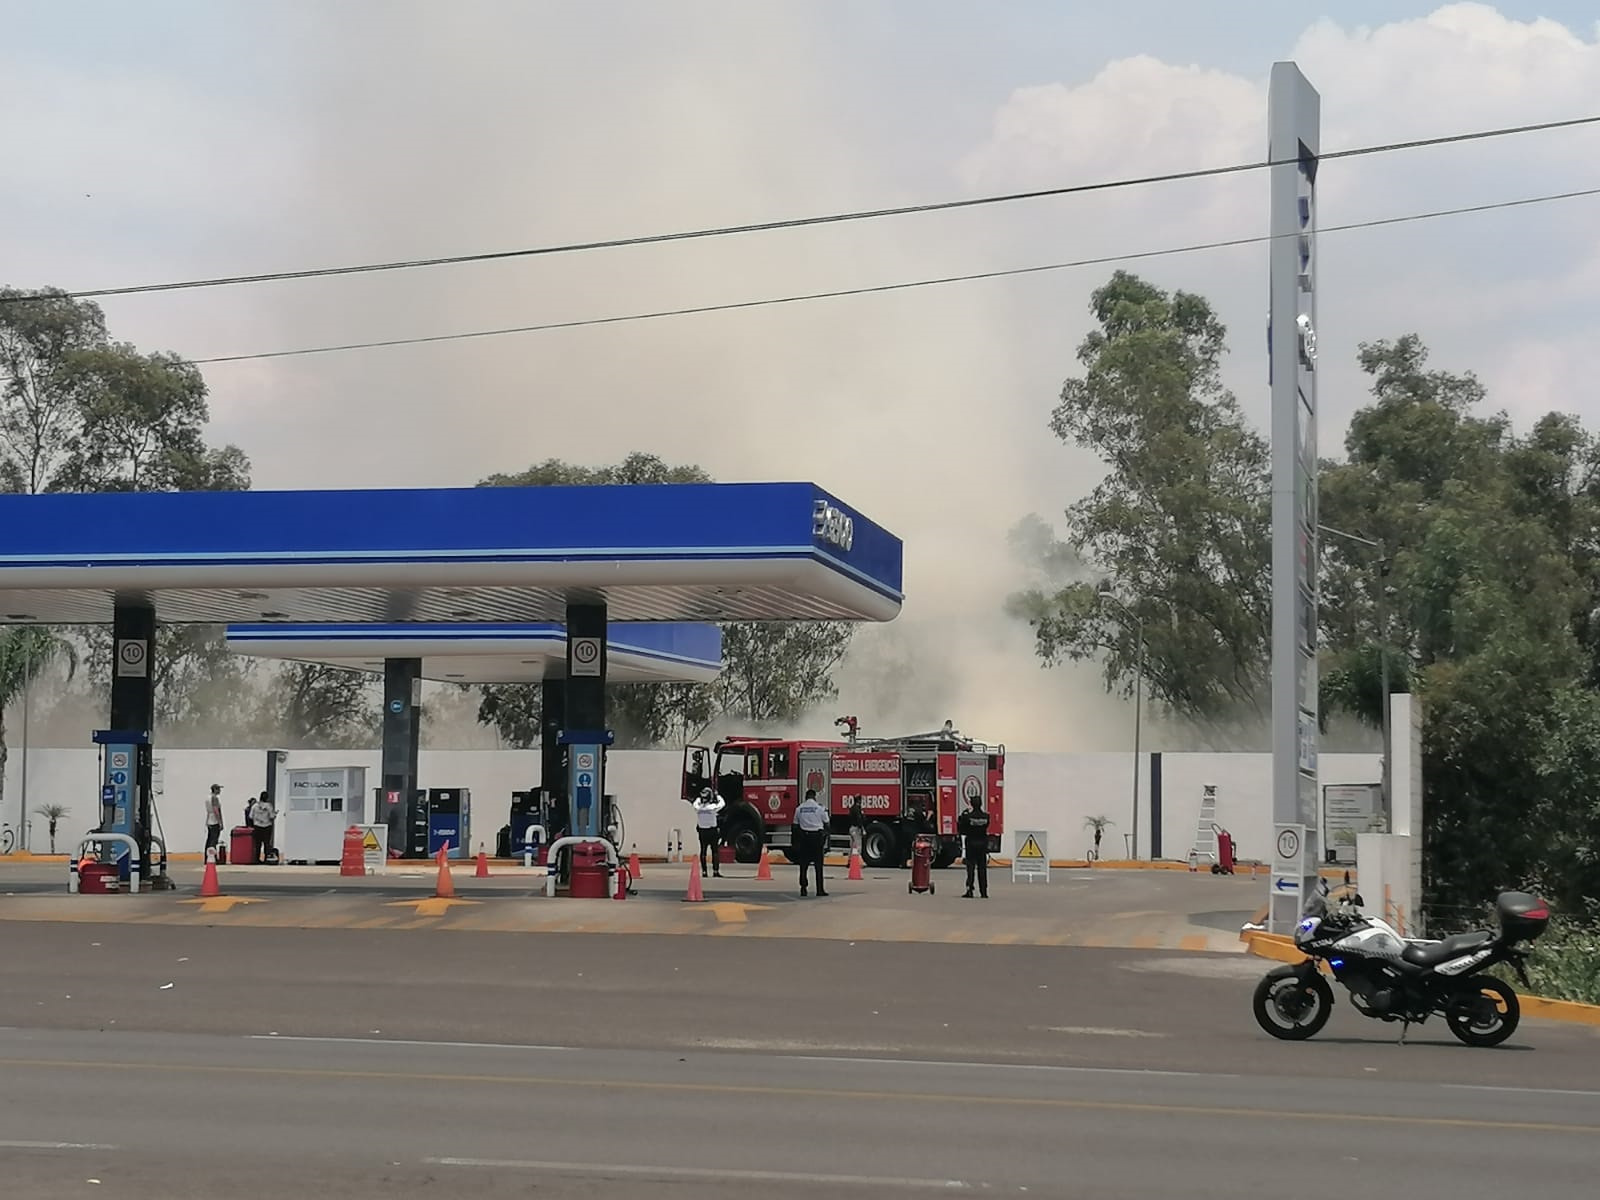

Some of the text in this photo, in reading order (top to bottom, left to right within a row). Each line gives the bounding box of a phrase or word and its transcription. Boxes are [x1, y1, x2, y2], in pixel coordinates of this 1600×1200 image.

[126, 647, 140, 658] 10
[579, 646, 593, 657] 10
[842, 795, 890, 809] BOBEROS
[1282, 836, 1295, 849] 10
